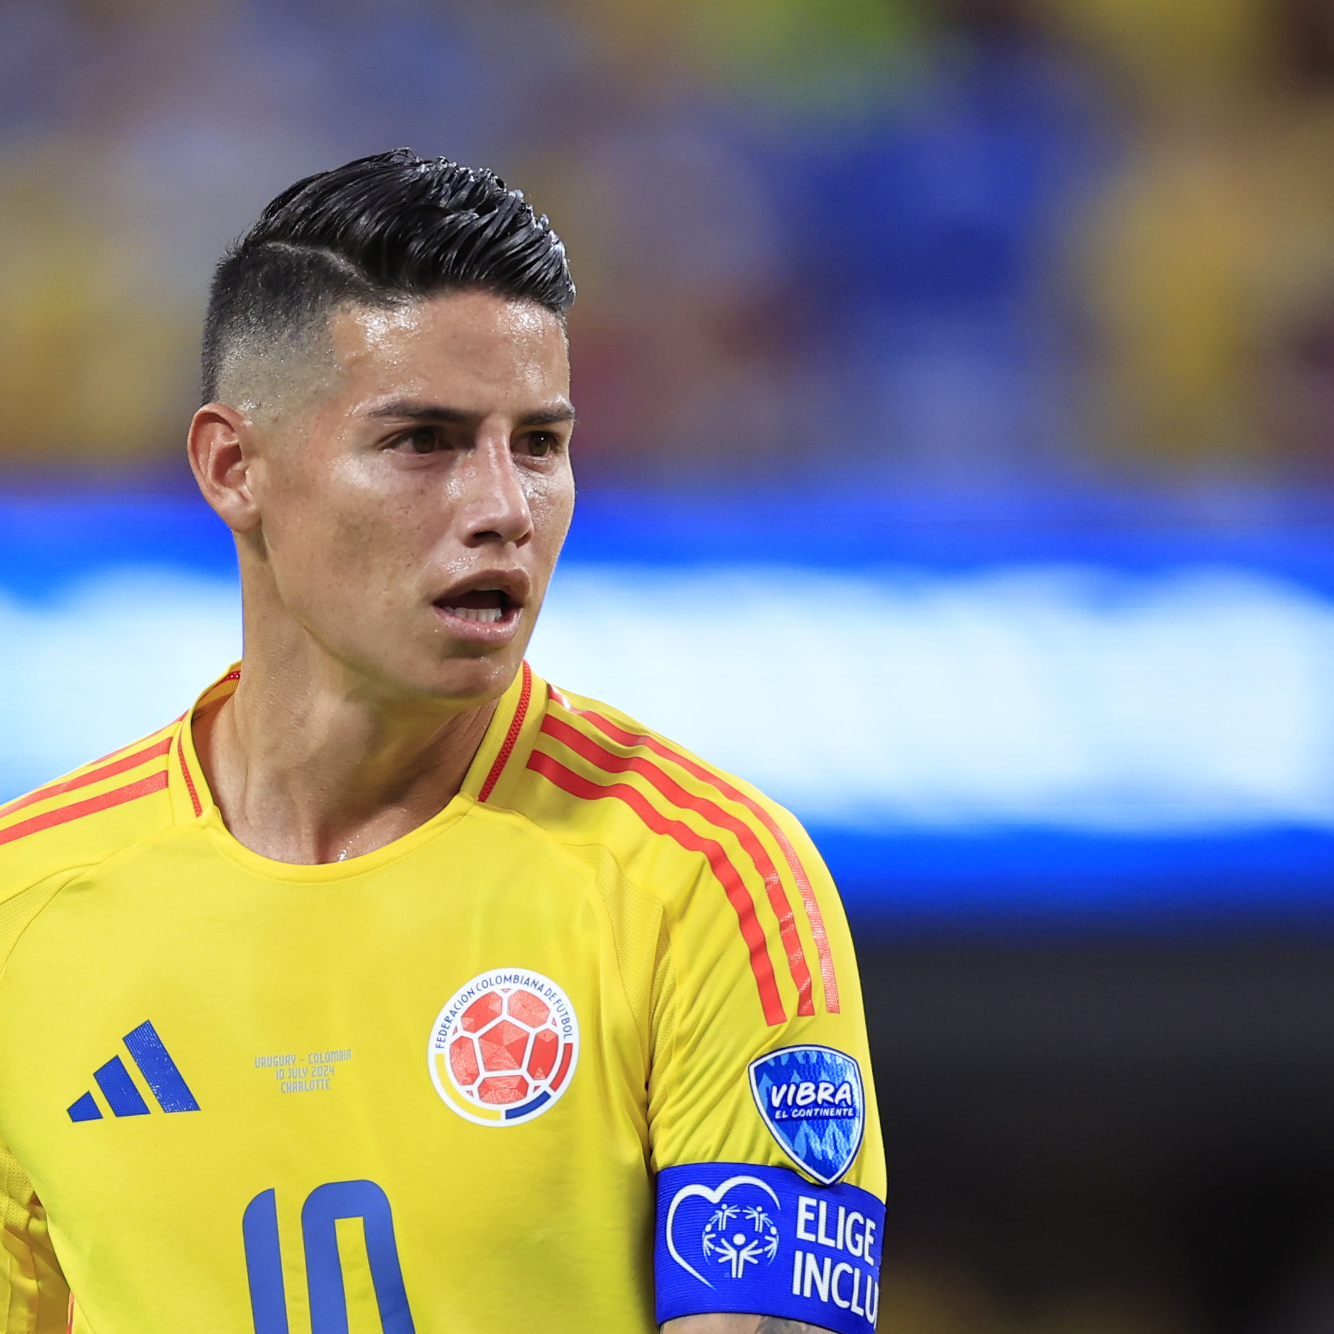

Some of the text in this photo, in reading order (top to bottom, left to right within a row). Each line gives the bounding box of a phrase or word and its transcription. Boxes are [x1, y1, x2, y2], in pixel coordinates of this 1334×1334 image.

[476, 974, 545, 992] COLOMBIANA
[543, 988, 558, 1002] DE
[552, 998, 573, 1039] FÚTBOL
[254, 1054, 296, 1068] URUGUAY
[308, 1048, 351, 1064] COLOMBIA
[275, 1065, 335, 1080] 10 JULY 2024
[280, 1078, 331, 1094] CHARLOTTE
[771, 1081, 852, 1108] VIBRA
[775, 1108, 854, 1119] EL CONTINENTE
[796, 1195, 876, 1266] ELIGE
[792, 1250, 879, 1330] INCLU
